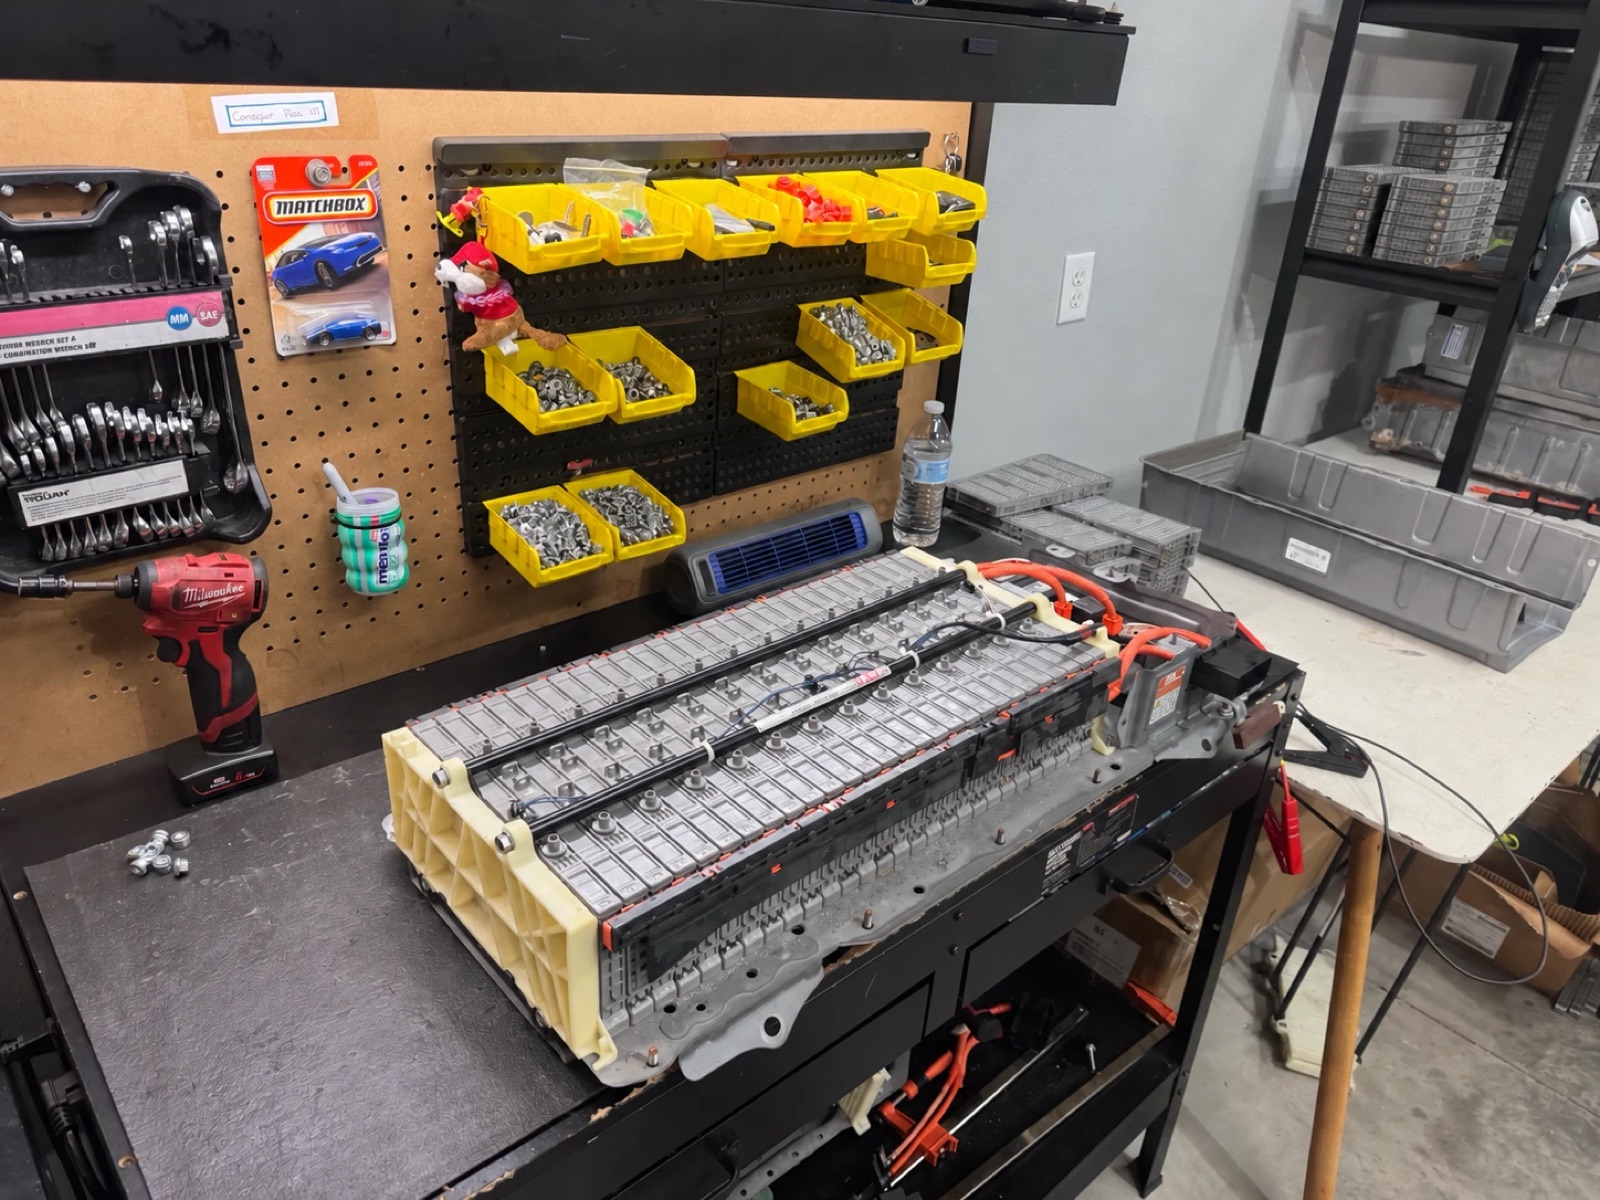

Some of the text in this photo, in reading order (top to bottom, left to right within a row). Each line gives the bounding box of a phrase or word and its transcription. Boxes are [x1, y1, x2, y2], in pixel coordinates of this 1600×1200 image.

[275, 197, 366, 216] MATCHBOX
[170, 313, 189, 325] MM
[200, 310, 219, 321] SAE
[183, 582, 244, 602] Milwaukee
